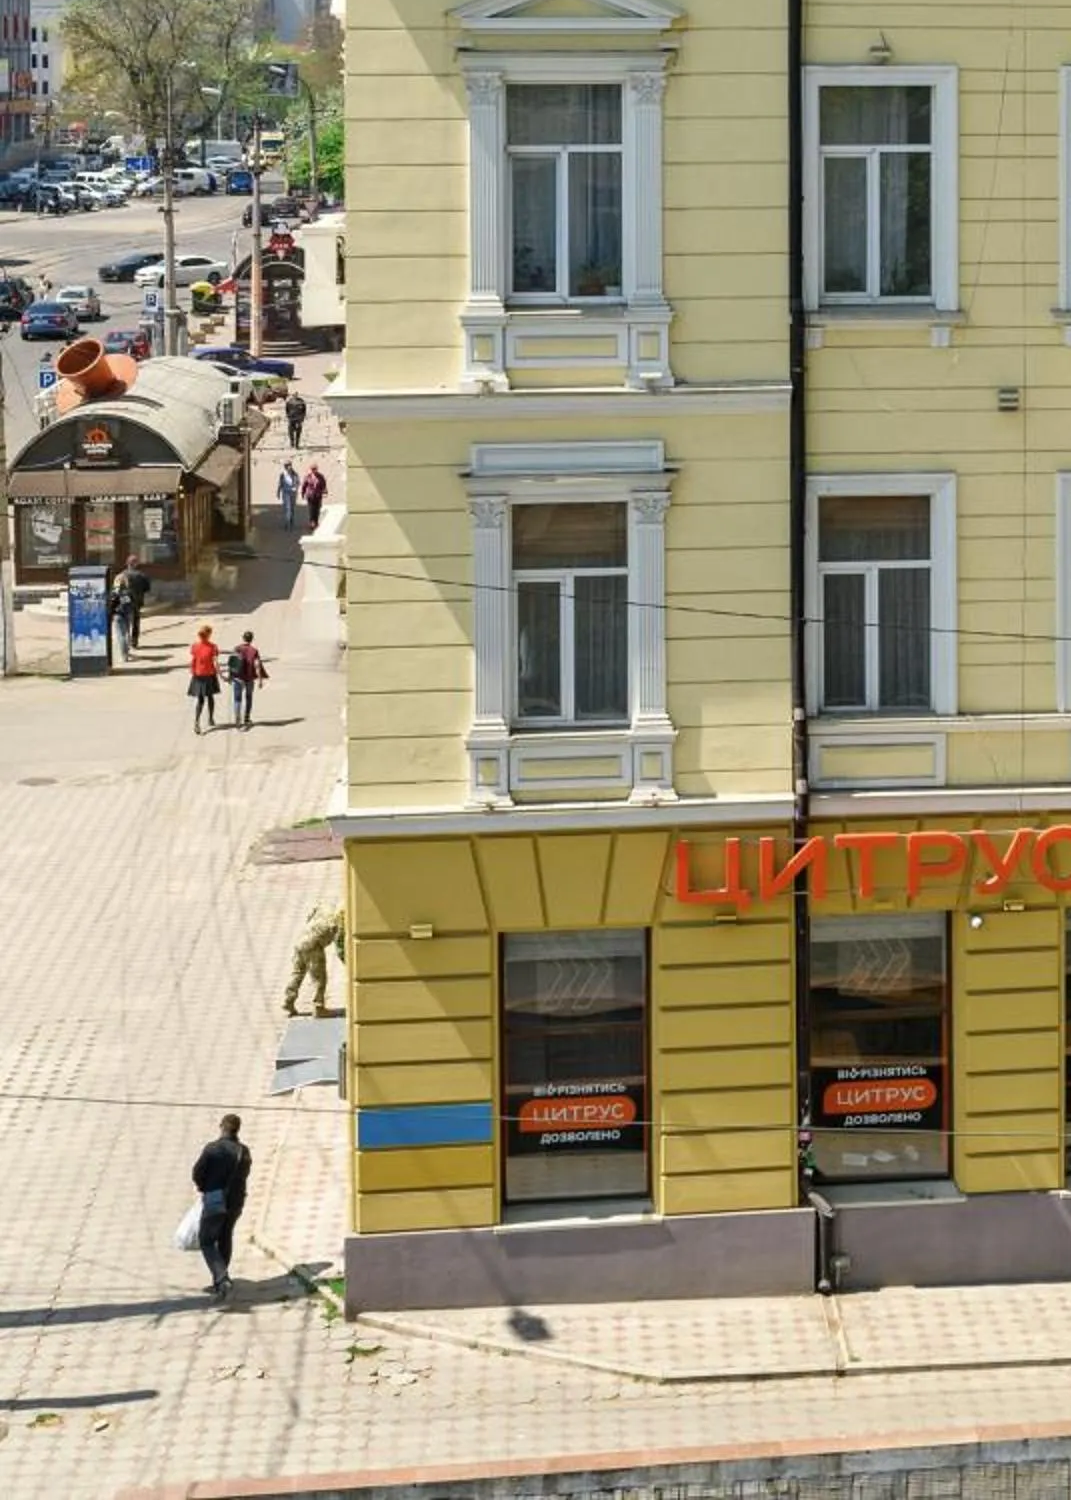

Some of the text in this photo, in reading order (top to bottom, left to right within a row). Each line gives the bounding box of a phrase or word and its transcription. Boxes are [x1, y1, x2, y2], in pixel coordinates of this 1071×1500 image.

[43, 373, 54, 387] P
[836, 1087, 926, 1106] ЦИТРУС
[532, 1103, 625, 1124] ЦИТРУС
[843, 1111, 922, 1127] ДОЗВОЛЕНО
[540, 1129, 621, 1145] ДОЗВОЛЕНО
